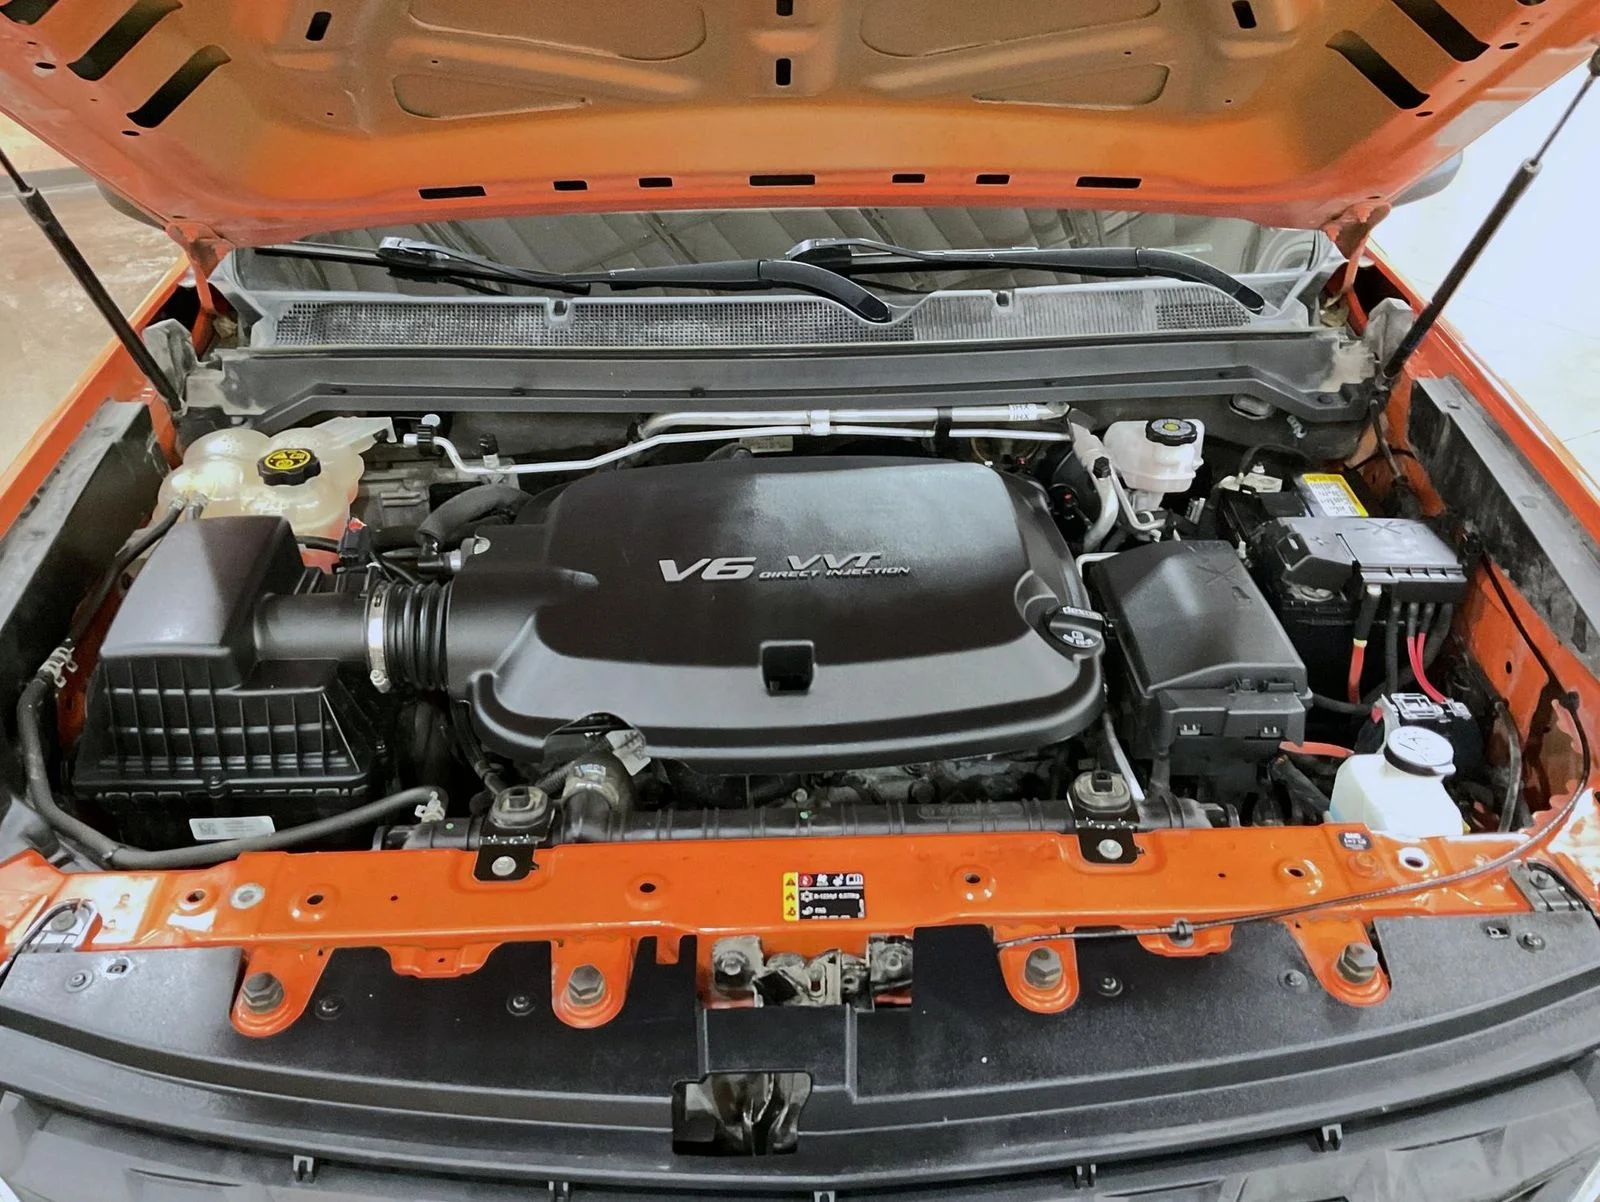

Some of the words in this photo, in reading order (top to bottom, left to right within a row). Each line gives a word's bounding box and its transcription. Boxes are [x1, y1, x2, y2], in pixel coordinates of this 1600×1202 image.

[658, 556, 757, 583] V6
[787, 551, 882, 571] VVT
[758, 568, 820, 579] DIRECT
[826, 566, 911, 576] INJECTION
